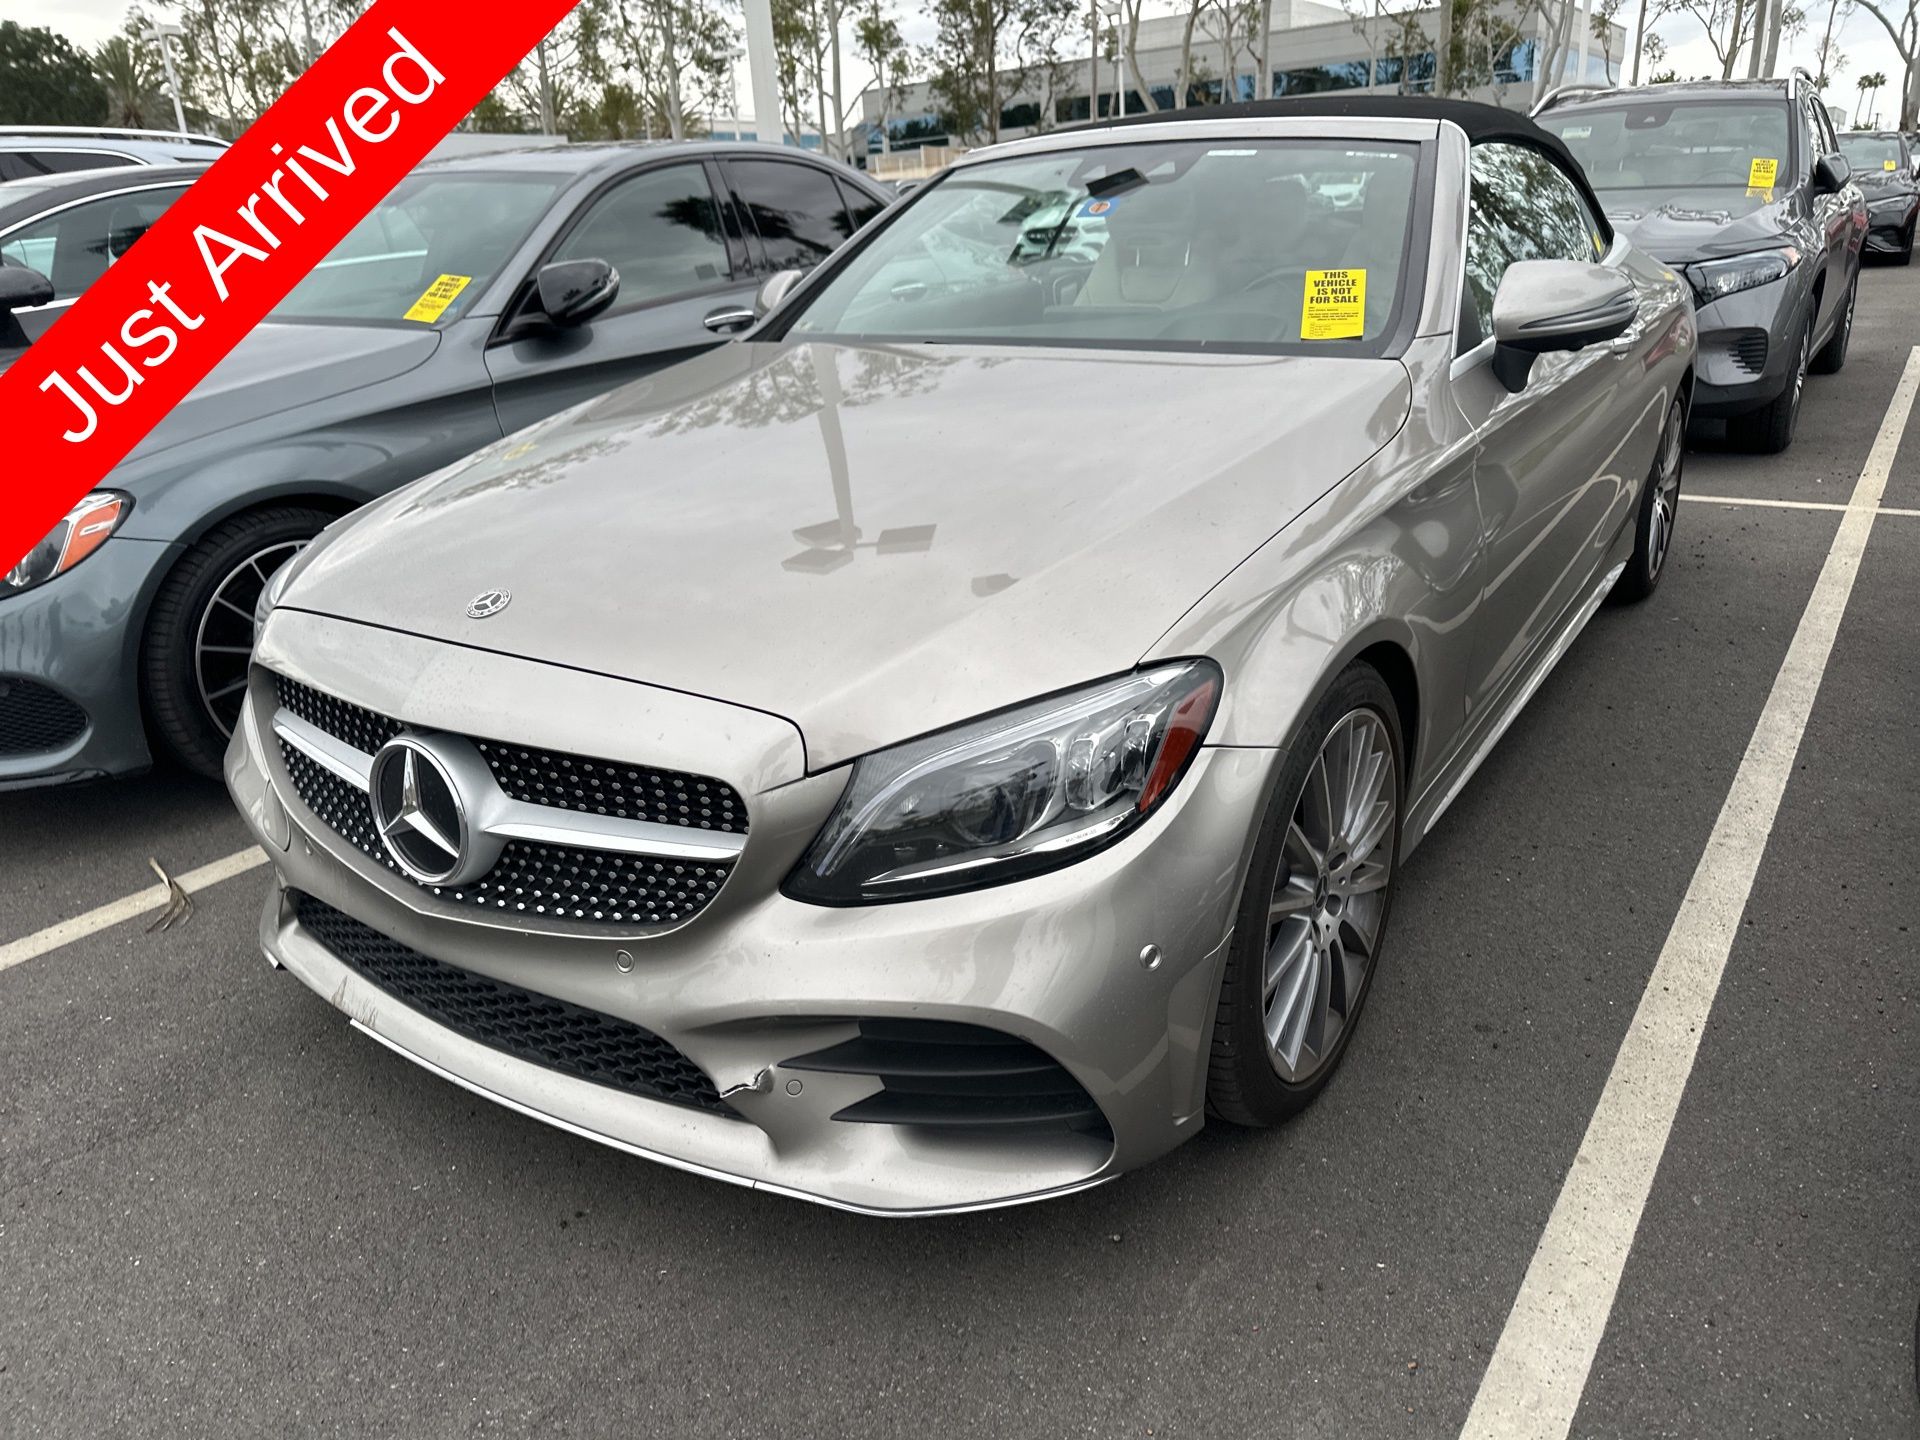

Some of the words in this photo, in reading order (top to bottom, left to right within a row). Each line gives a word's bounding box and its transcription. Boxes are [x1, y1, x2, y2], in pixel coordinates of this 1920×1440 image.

[1323, 271, 1348, 279] THIS
[1313, 279, 1357, 287] VEHICLE
[1331, 287, 1352, 295] NOT
[1310, 296, 1330, 304] FOR
[1333, 295, 1358, 303] SALE
